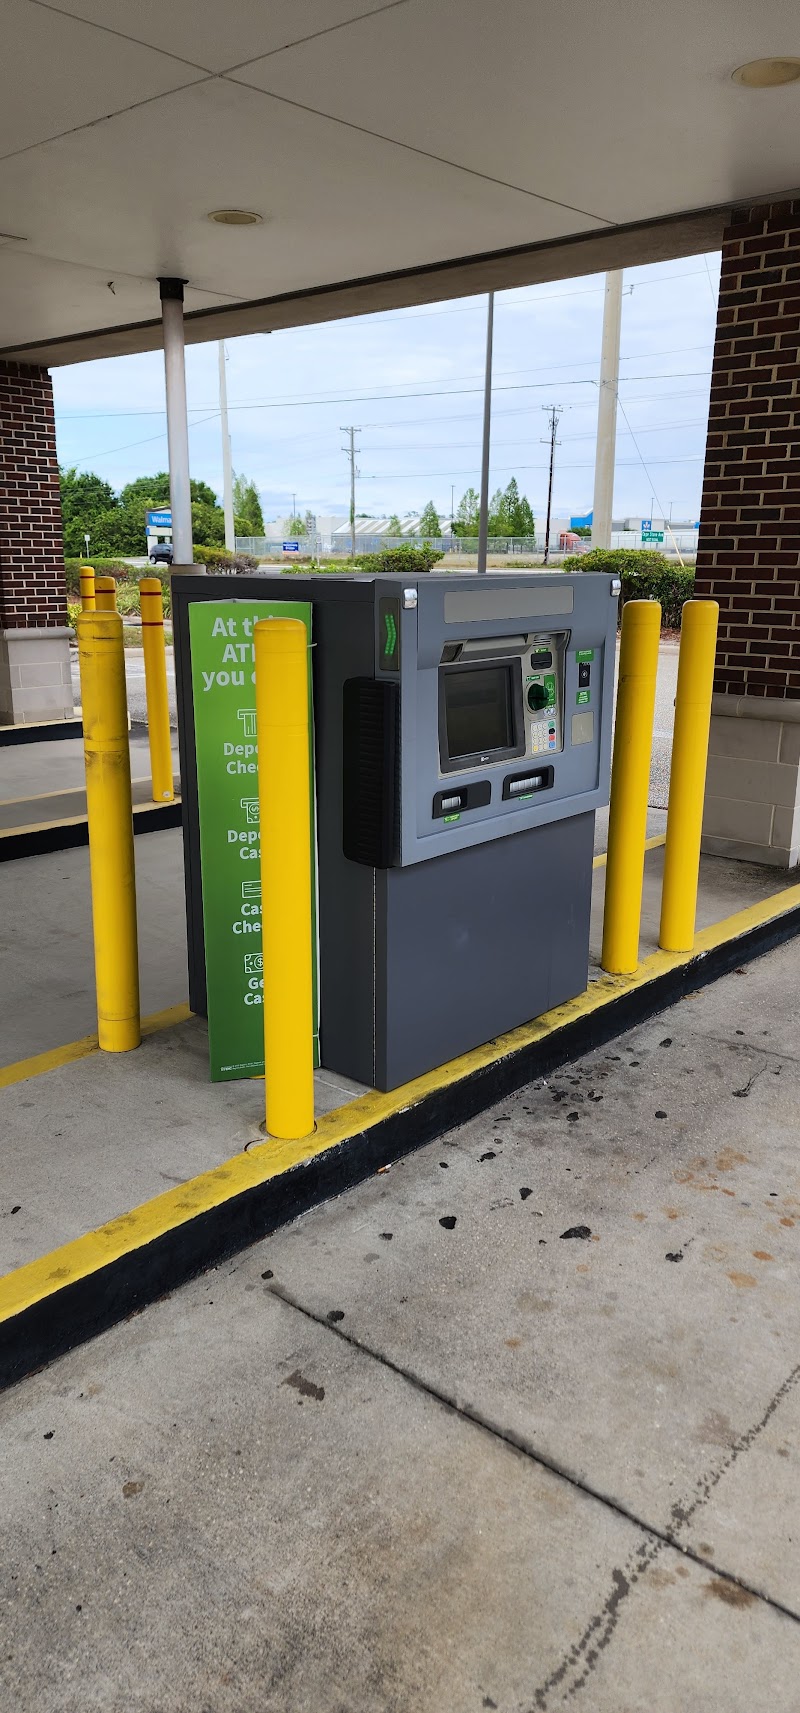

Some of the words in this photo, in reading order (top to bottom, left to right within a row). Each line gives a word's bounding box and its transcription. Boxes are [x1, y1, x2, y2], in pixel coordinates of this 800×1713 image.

[151, 515, 172, 523] Walma
[211, 617, 238, 637] At
[222, 643, 256, 663] AT
[201, 670, 245, 692] you
[226, 760, 259, 775] Che
[227, 829, 261, 845] Dep
[232, 920, 262, 935] Che
[243, 992, 264, 1006] Ca
